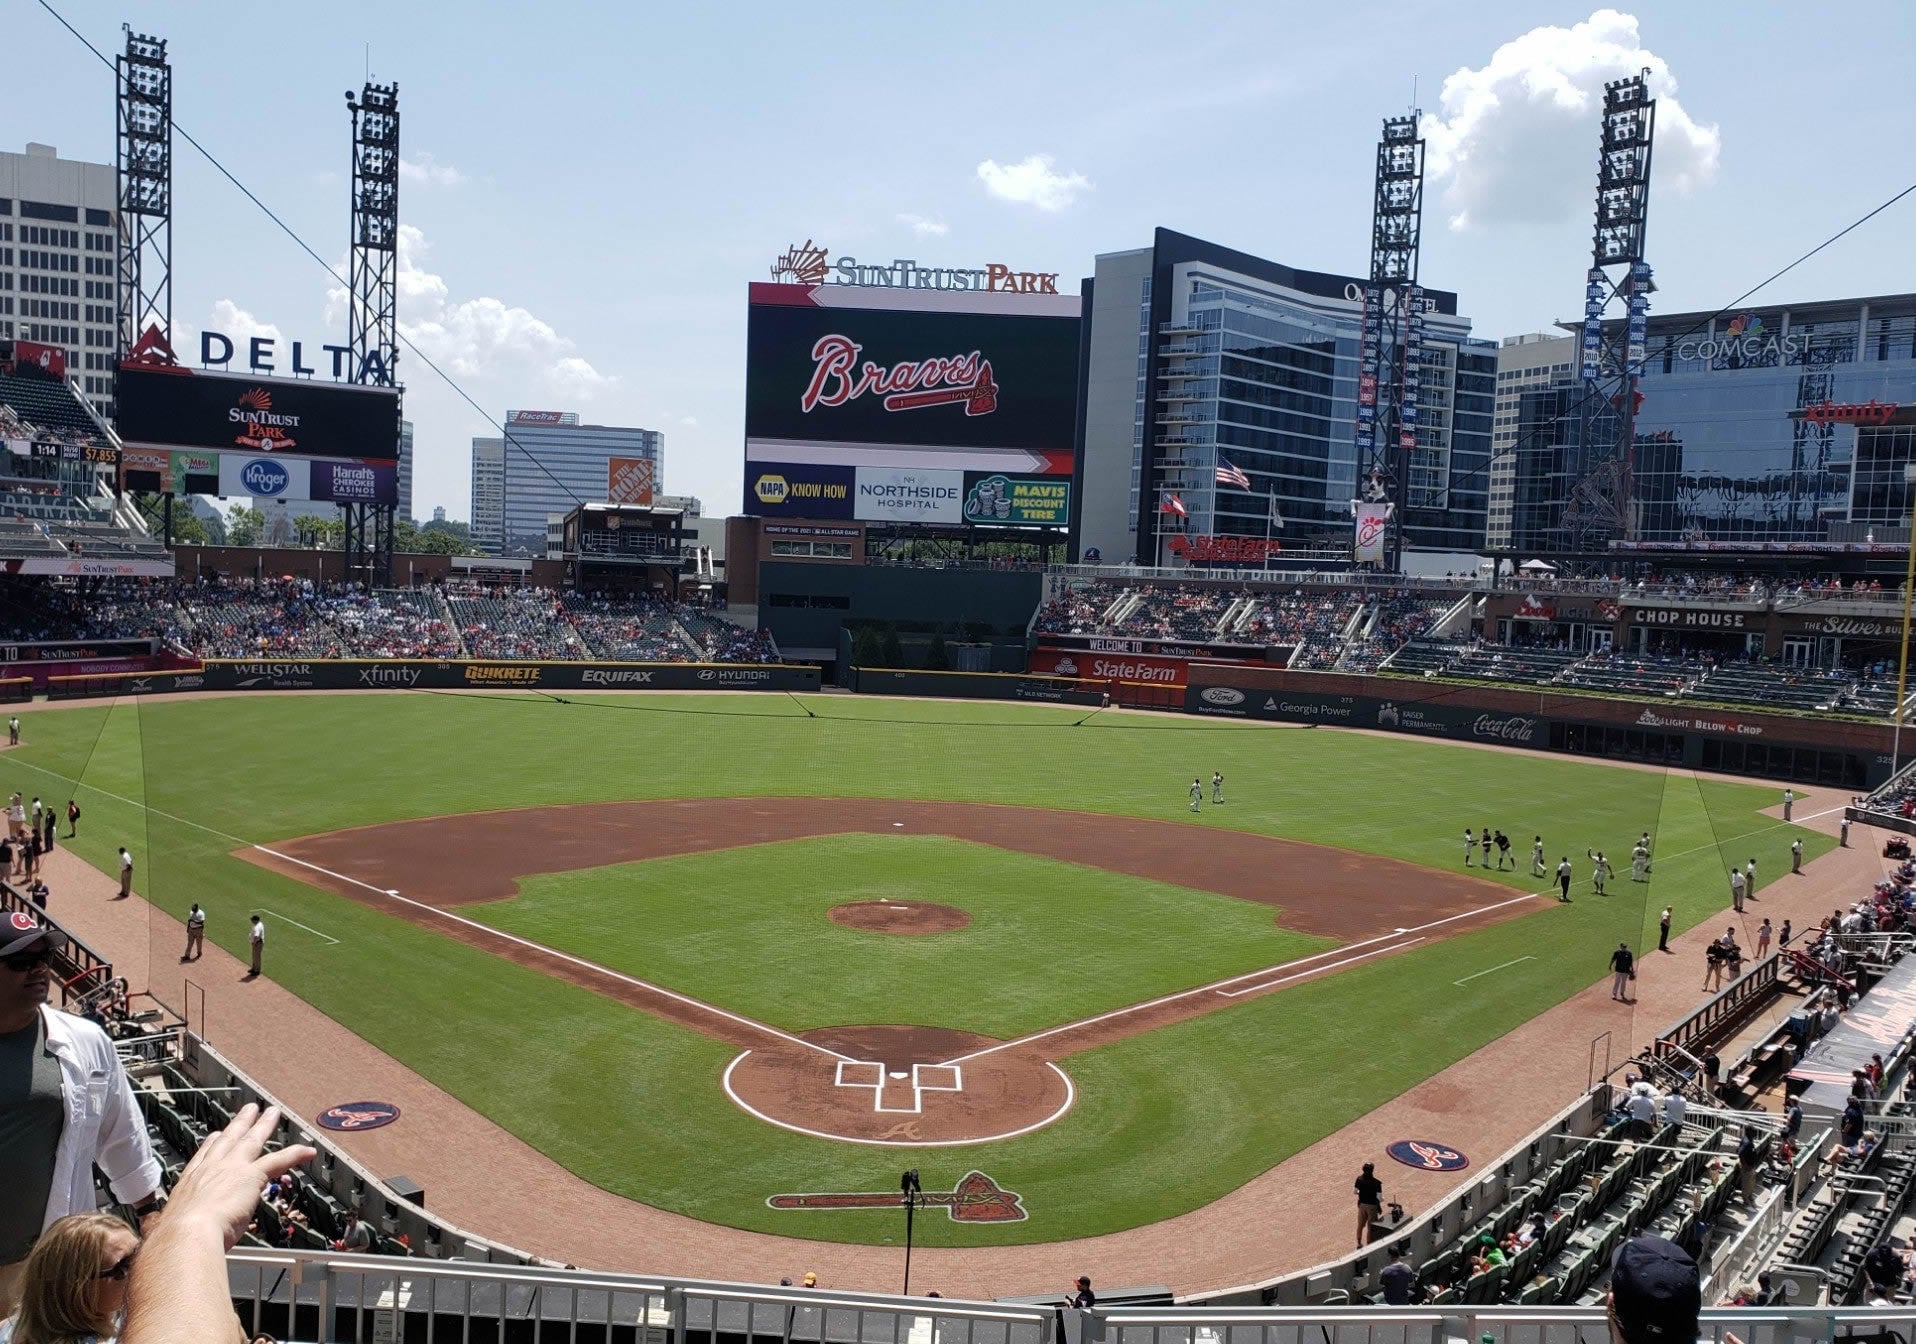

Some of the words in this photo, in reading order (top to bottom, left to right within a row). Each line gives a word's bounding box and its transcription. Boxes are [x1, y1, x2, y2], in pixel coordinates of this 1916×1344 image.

[1586, 320, 1601, 329] 2002
[1679, 333, 1815, 361] COMCAST
[201, 331, 392, 387] DELTA
[1584, 352, 1598, 361] 2010
[801, 334, 981, 413] Braves
[1583, 368, 1597, 378] 2013
[520, 412, 558, 421] RaceTrac
[1805, 398, 1899, 429] xfinity
[247, 423, 286, 439] PARK
[37, 444, 57, 456] 1:14
[85, 447, 117, 462] $7,855
[246, 464, 286, 492] Kroger
[332, 465, 375, 480] Harrah's
[614, 463, 632, 480] THE
[333, 477, 375, 487] CHEROKEE
[609, 459, 655, 502] HOME
[332, 485, 375, 494] CASINOS
[626, 477, 653, 503] DEPOT
[760, 482, 784, 496] NAPA
[791, 483, 822, 497] KNOW
[823, 484, 847, 499] HOW
[860, 484, 959, 499] NORTHSIDE
[1013, 485, 1066, 497] MAVIS
[878, 498, 940, 510] HOSPITAL
[1013, 499, 1065, 509] DISCOUNT
[1021, 509, 1056, 520] TIRE
[1636, 609, 1680, 624] CHOP
[1686, 611, 1744, 628] HOUSE
[1804, 621, 1821, 630] THE
[1822, 616, 1883, 635] Silver
[1885, 626, 1916, 634] BULE
[1090, 639, 1134, 651] WELCOME
[1135, 641, 1143, 653] TO
[4, 647, 18, 661] TO
[81, 665, 109, 674] NOBODY
[234, 664, 313, 677] WELLSTAR
[359, 664, 422, 686] xfinity
[465, 665, 541, 680] QUIKRETE
[719, 670, 770, 680] HYUNDAI
[273, 679, 291, 687] Health
[293, 680, 313, 688] System
[582, 670, 653, 685] EQUIFAX
[1037, 691, 1062, 699] NETWORK
[1209, 689, 1236, 702] Ford
[1280, 702, 1318, 716] Georgia
[1321, 704, 1351, 717] Power
[1402, 711, 1424, 720] KAISER
[1665, 719, 1690, 728] LIGHT
[1695, 719, 1726, 731] BELOW
[1737, 724, 1763, 735] CHOP
[1876, 755, 1894, 764] 325
